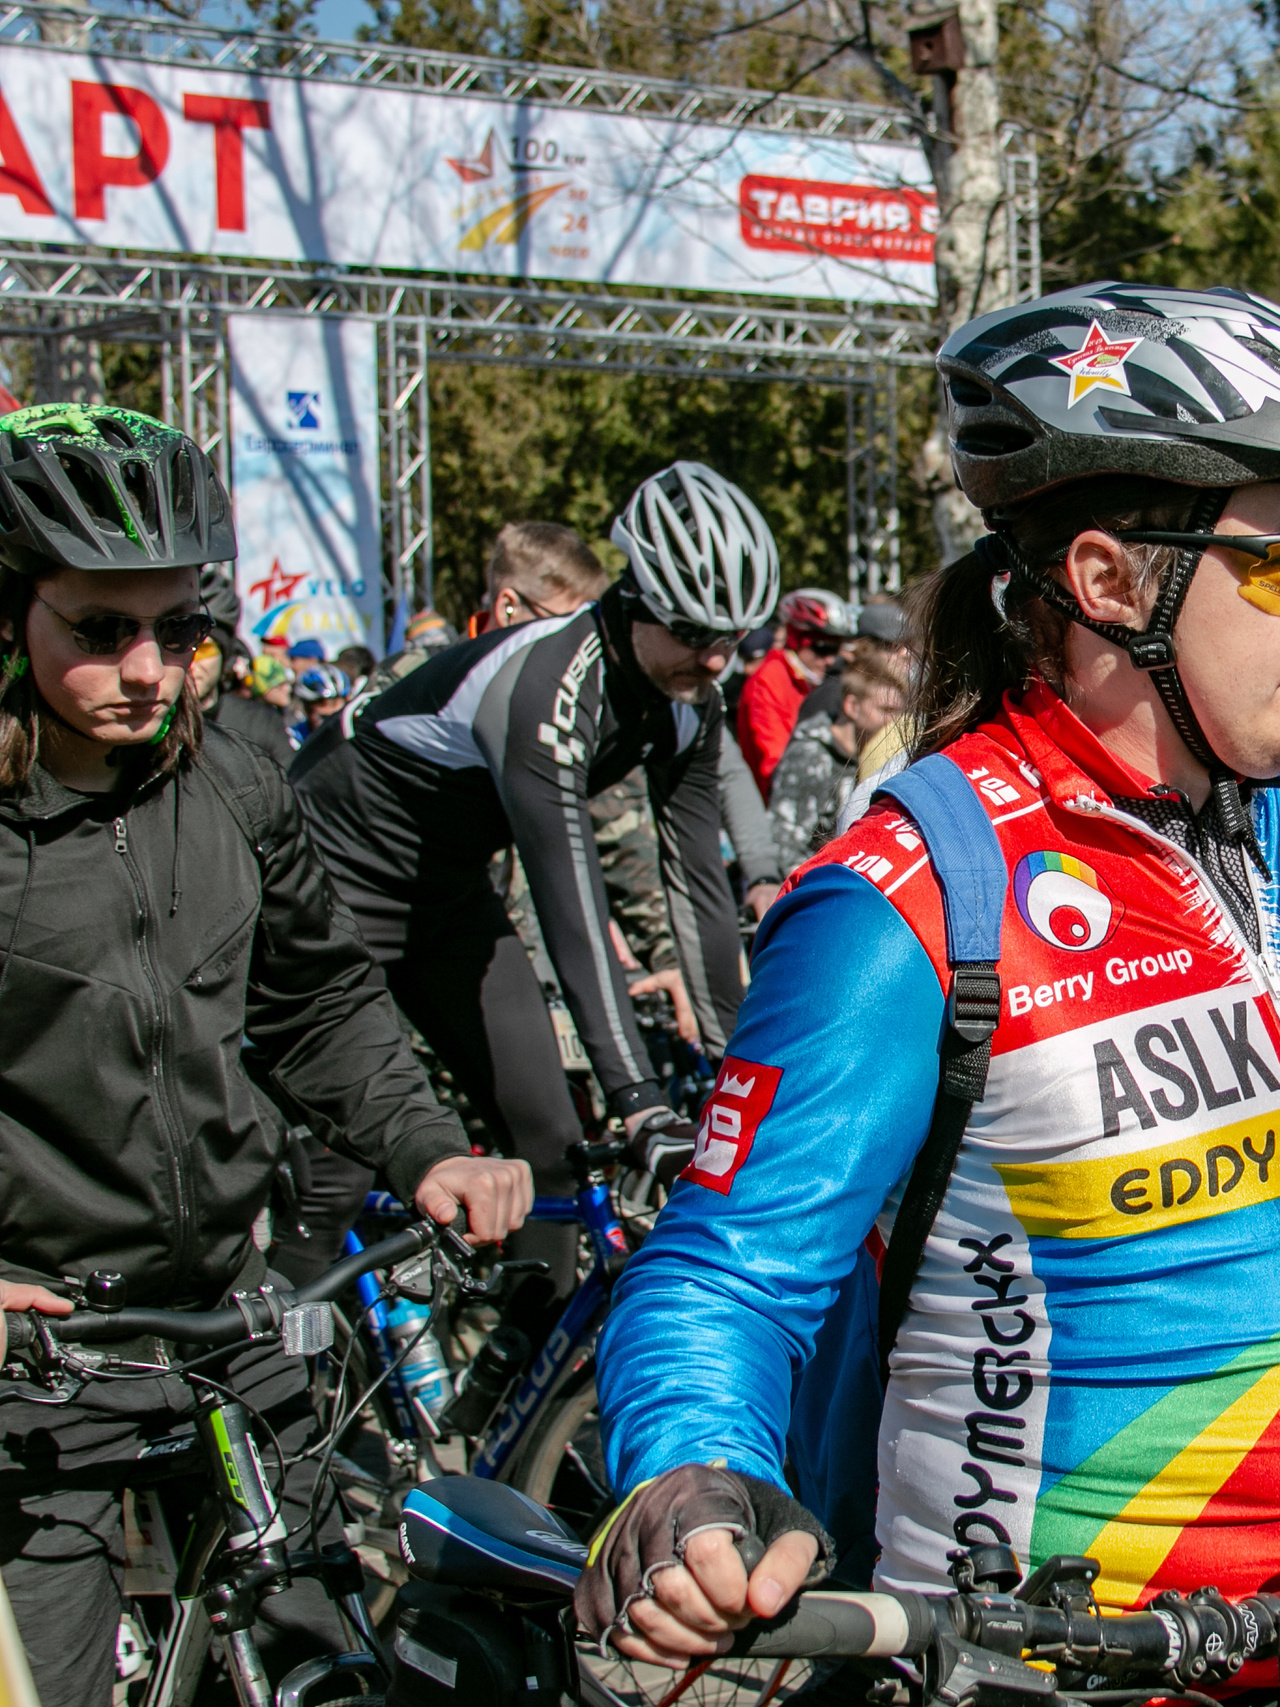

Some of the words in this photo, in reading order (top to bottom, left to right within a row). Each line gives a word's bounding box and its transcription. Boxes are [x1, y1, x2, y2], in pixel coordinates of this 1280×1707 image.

[511, 137, 558, 162] 100
[562, 213, 588, 233] 24
[750, 189, 912, 232] ТАВРИЯ
[302, 613, 373, 633] RALLY
[553, 631, 602, 732] CUBE
[1008, 957, 1094, 1018] Berry
[1105, 948, 1193, 986] Group
[1110, 1130, 1277, 1215] EDDY
[399, 1522, 416, 1564] GIANT
